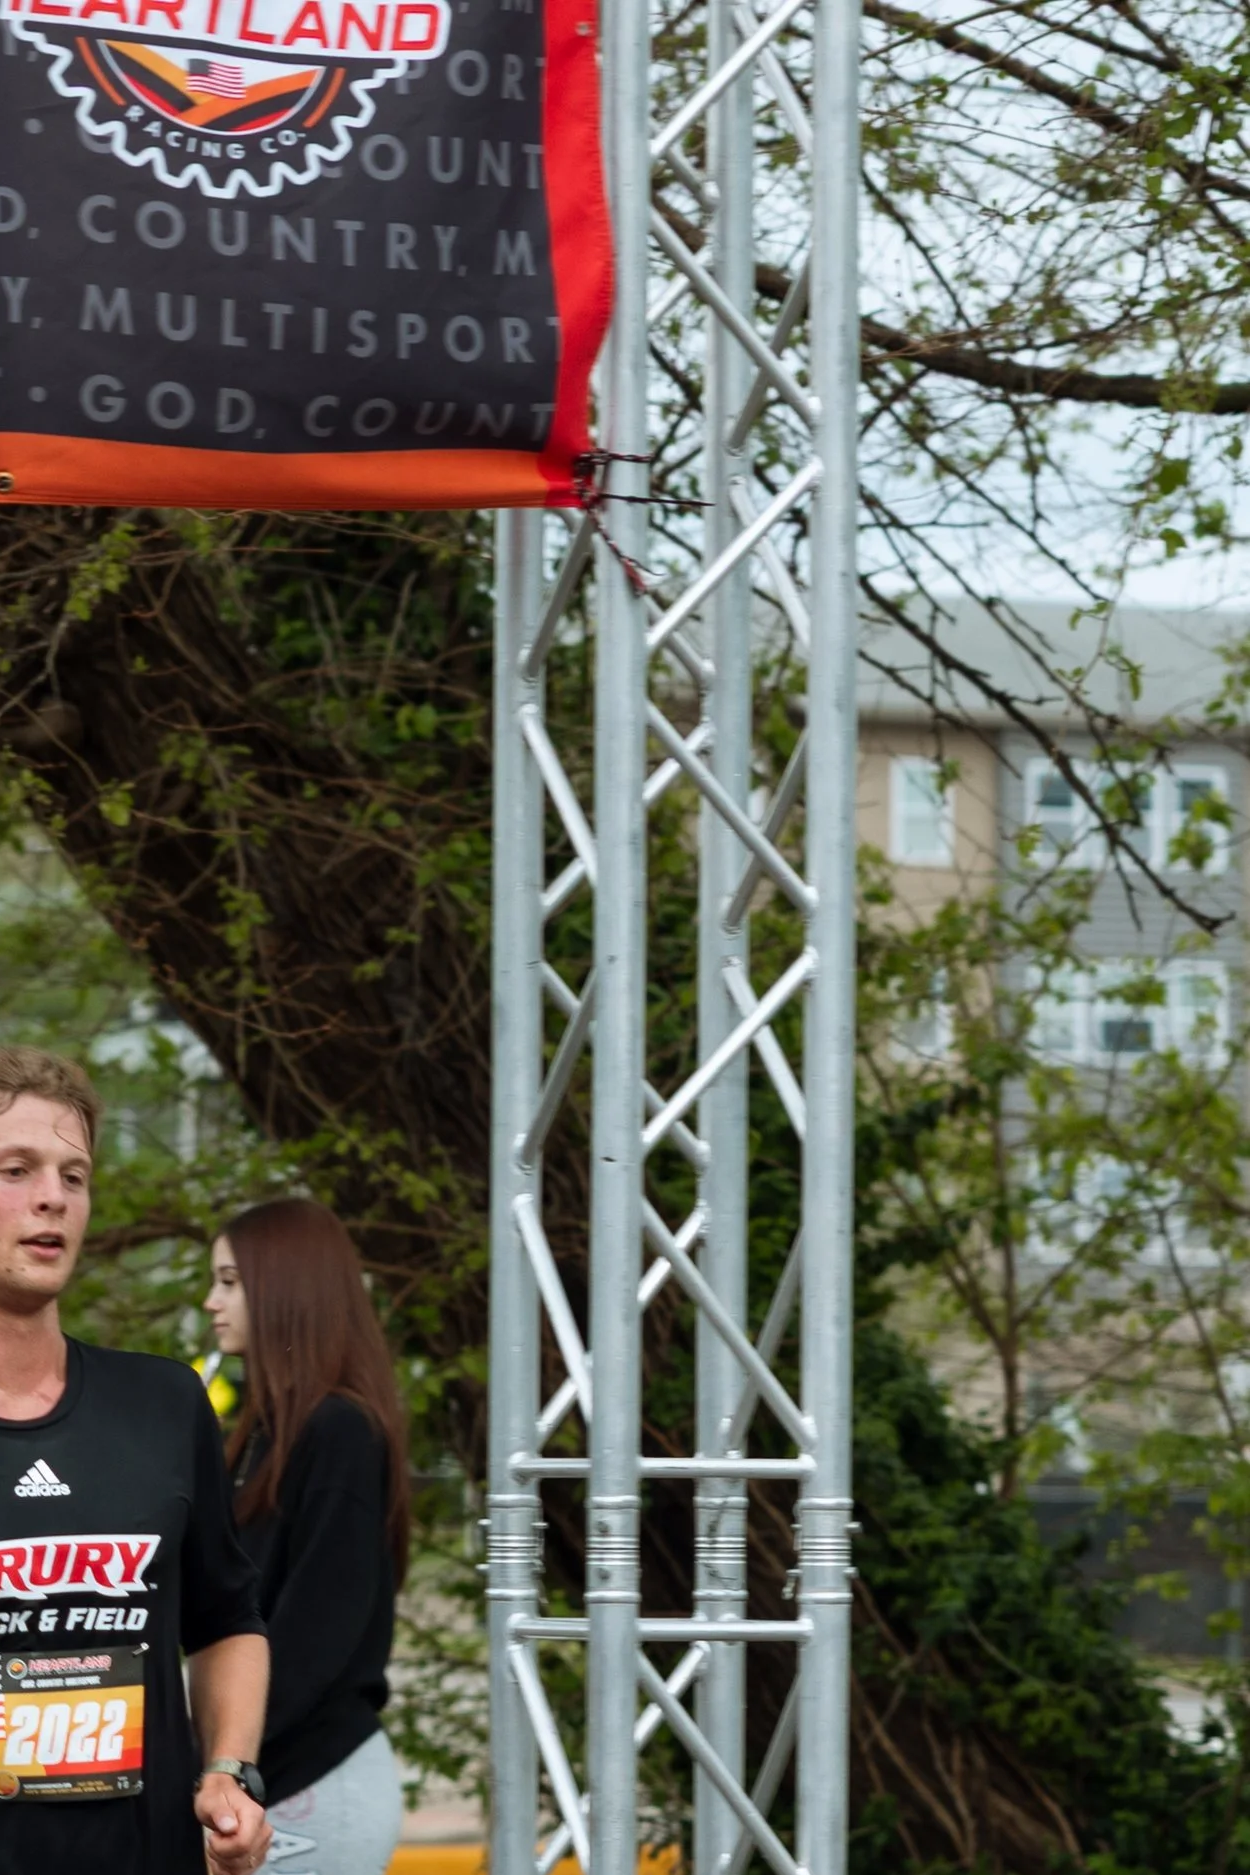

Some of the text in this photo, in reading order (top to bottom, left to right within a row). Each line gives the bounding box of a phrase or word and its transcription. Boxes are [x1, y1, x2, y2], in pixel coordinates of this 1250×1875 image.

[395, 49, 546, 101] POR
[124, 104, 246, 160] RACING
[321, 133, 544, 190] OUNT
[77, 194, 468, 277] COUNTRY,
[79, 374, 266, 441] GOD,
[14, 1482, 71, 1498] adidas
[37, 1609, 59, 1632] &
[65, 1607, 149, 1632] FIELD
[3, 1698, 128, 1766] 2022
